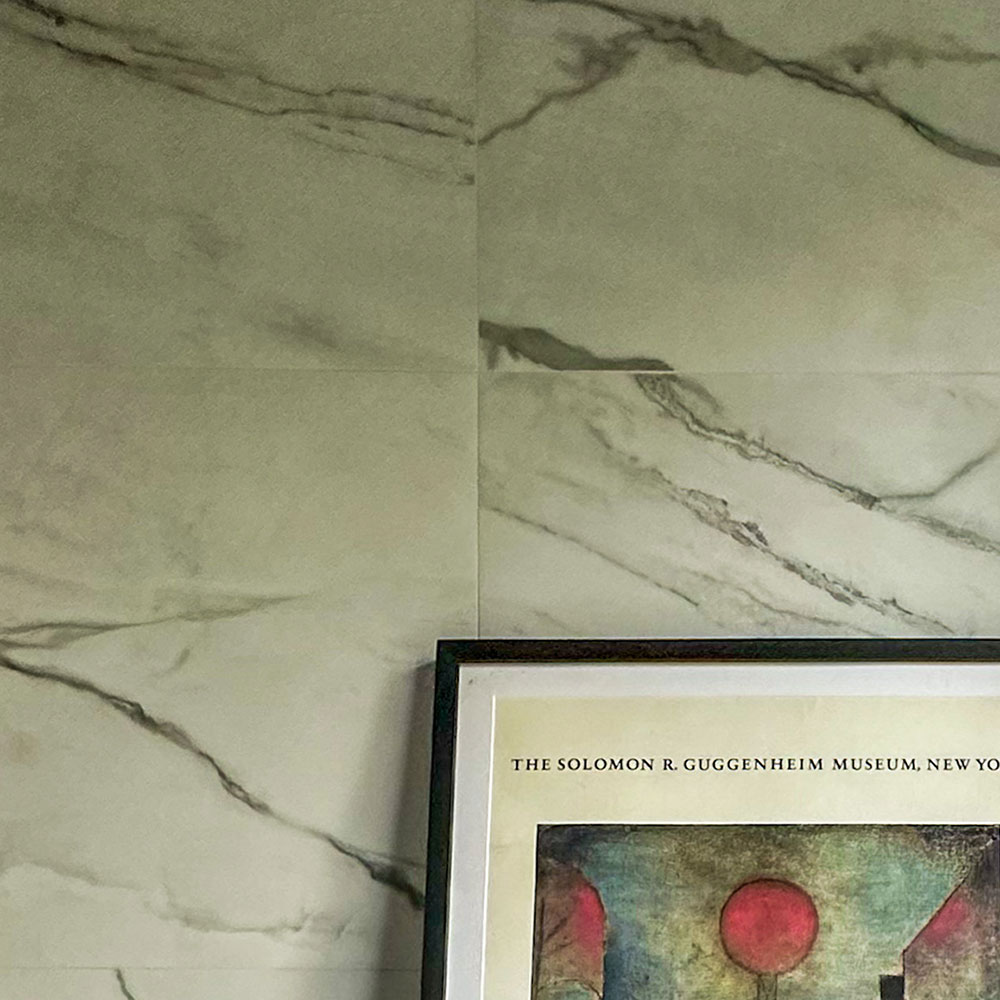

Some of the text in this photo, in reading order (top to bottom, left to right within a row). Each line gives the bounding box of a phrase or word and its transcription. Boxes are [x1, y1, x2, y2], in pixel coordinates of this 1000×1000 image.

[511, 758, 551, 771] THE
[557, 757, 655, 771] SOLOMON
[662, 758, 678, 771] R.
[683, 757, 824, 772] GUGGENHEIM
[832, 757, 921, 773] MUSEUM,
[926, 758, 971, 771] NEW
